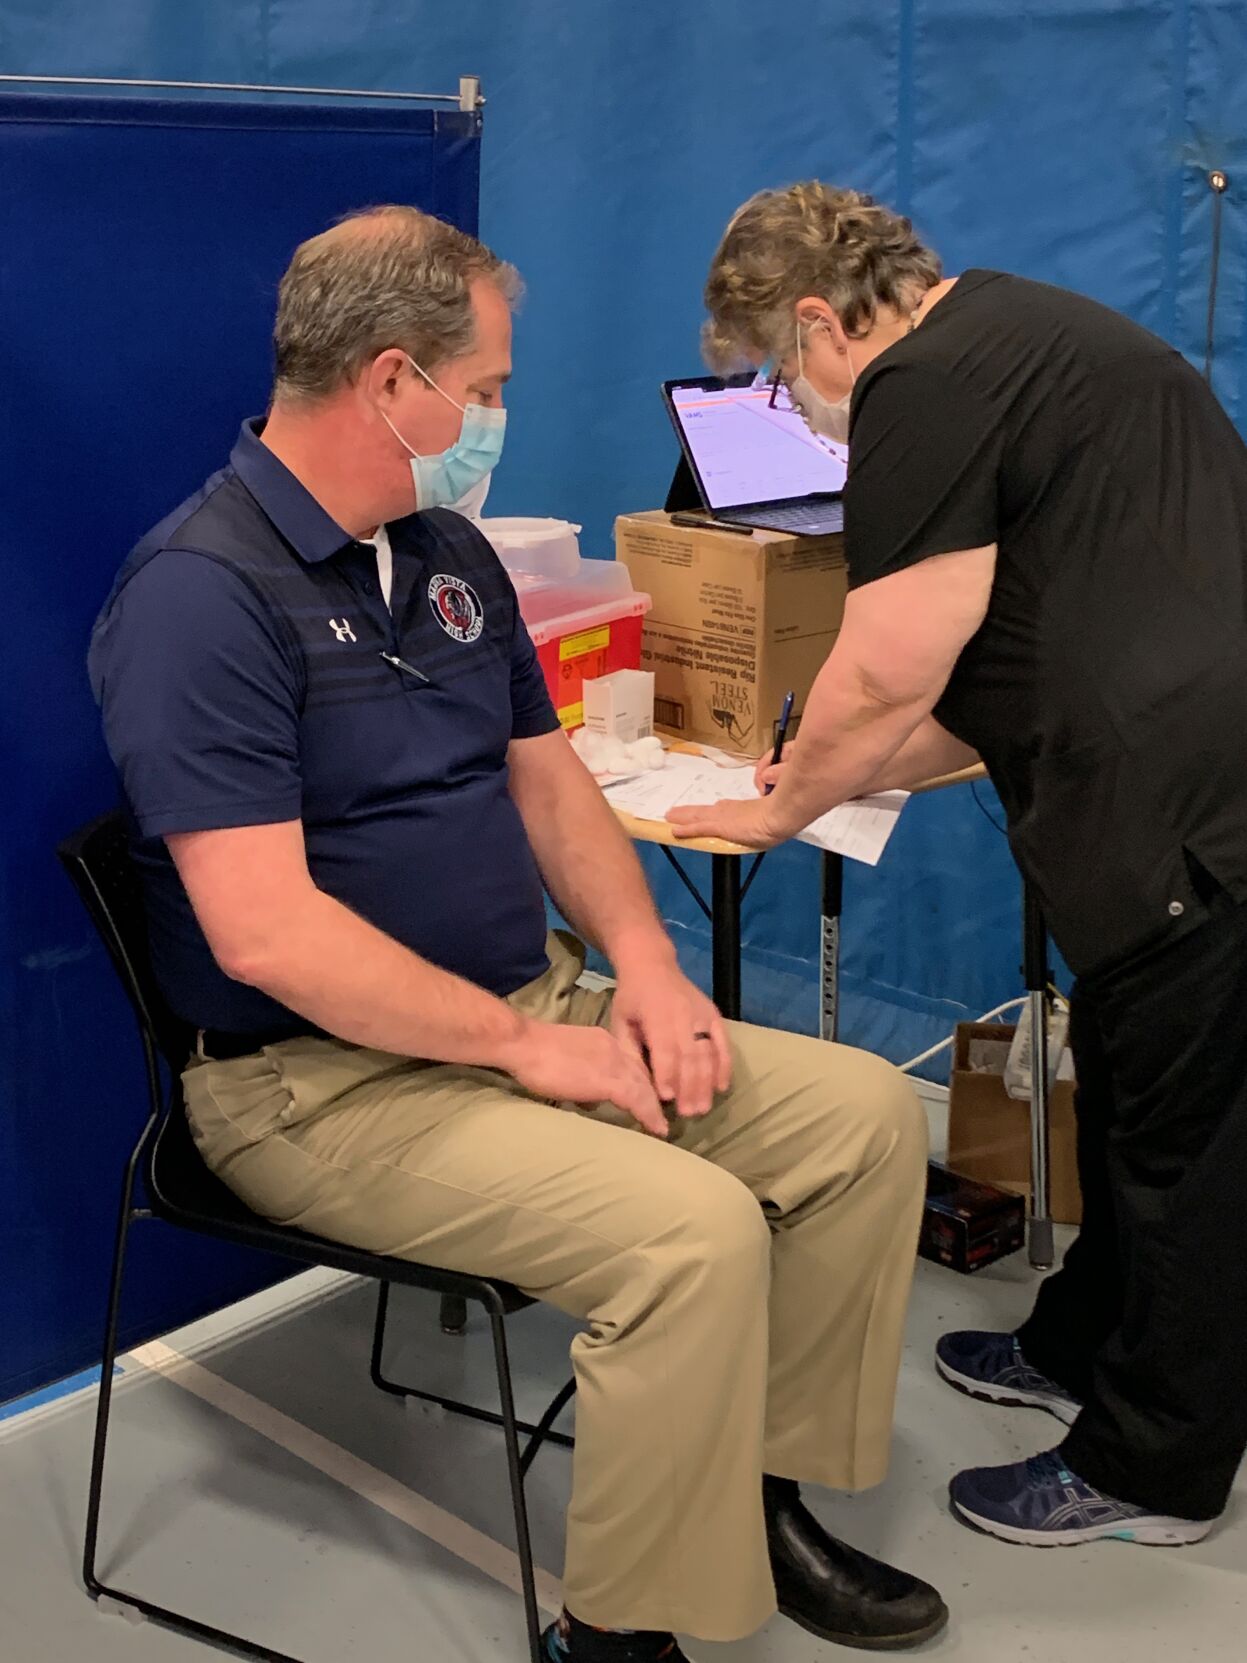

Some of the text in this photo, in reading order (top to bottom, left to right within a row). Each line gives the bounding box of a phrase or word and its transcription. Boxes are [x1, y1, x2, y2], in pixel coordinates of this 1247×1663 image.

[653, 652, 694, 670] Industrial
[675, 645, 756, 671] Disposable Nitrile
[695, 661, 737, 680] Resistant
[740, 670, 756, 683] Rip
[710, 681, 749, 699] STEEL
[712, 694, 752, 716] VENOM
